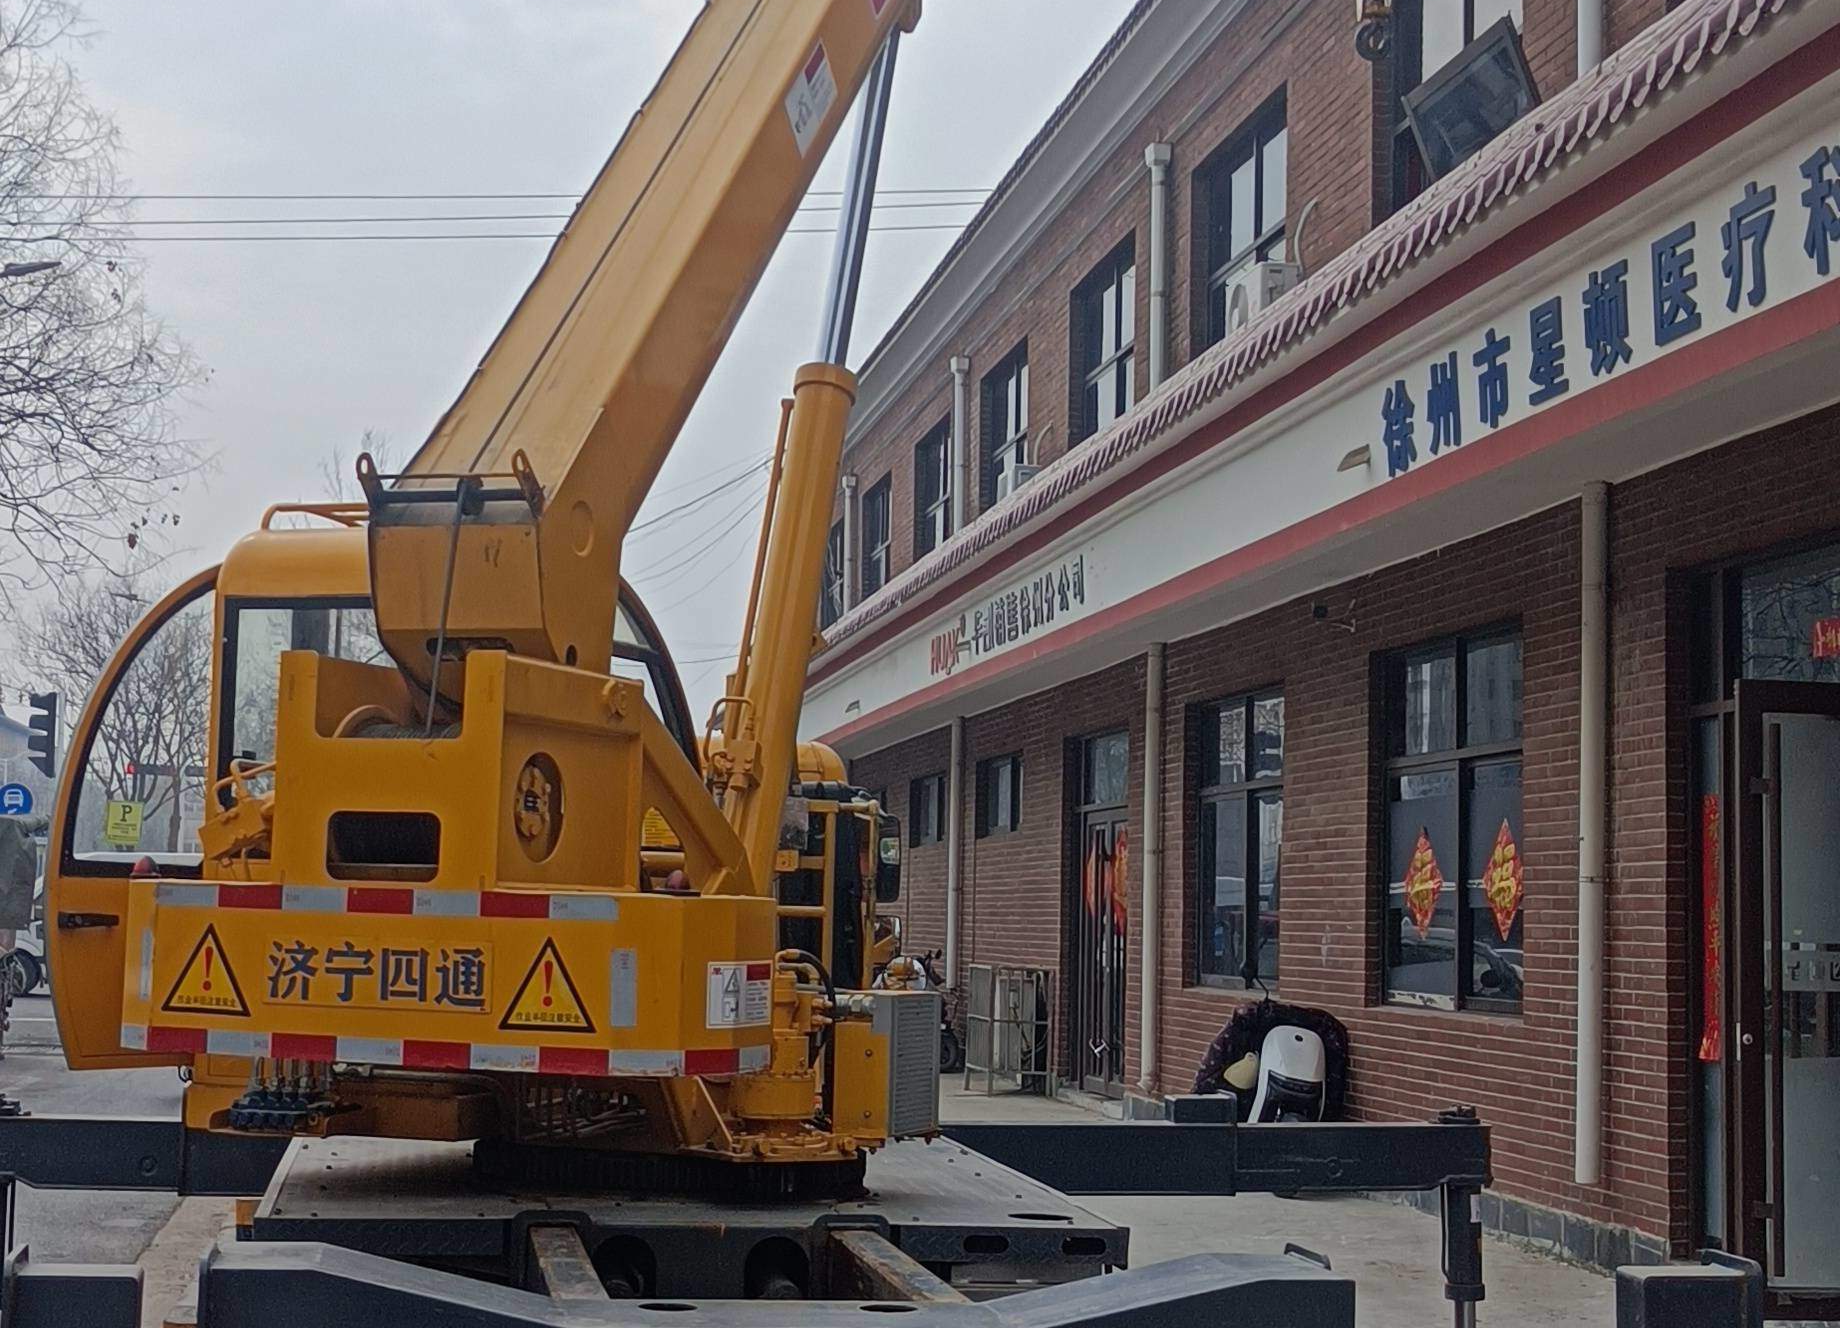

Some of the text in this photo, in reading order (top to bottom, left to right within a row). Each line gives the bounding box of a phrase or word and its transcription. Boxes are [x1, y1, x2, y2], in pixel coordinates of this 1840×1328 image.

[1381, 145, 1840, 478] 徐州市星顿医疗科
[120, 804, 132, 822] P
[268, 939, 486, 1008] 济宁四通
